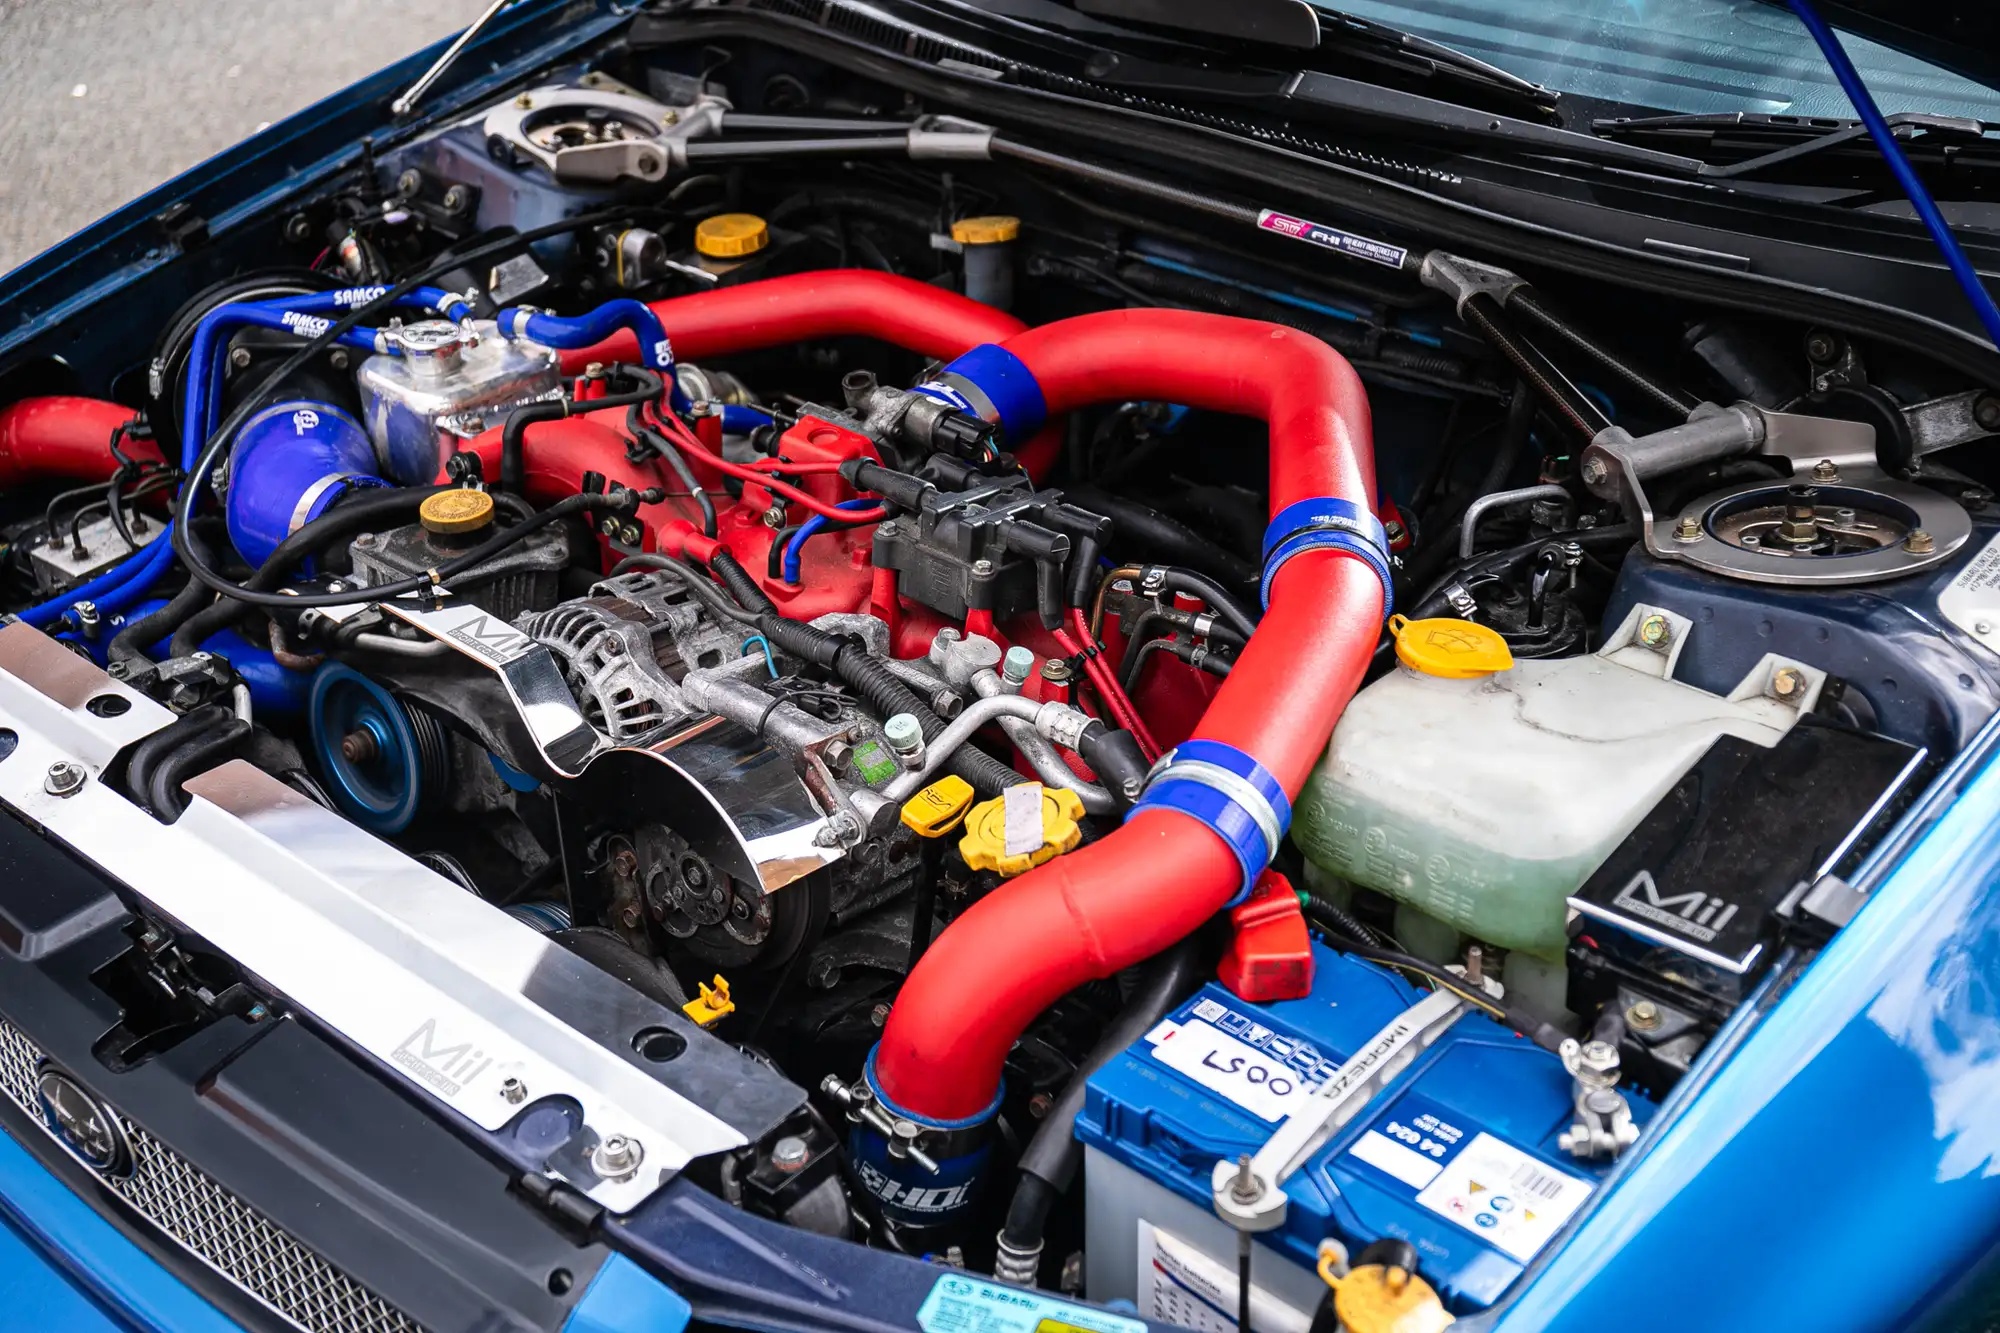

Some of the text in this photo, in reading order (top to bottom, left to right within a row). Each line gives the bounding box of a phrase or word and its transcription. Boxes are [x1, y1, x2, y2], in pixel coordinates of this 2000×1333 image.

[1311, 230, 1340, 245] FHI
[1347, 244, 1394, 263] Aerospace Division
[1366, 244, 1391, 257] INDUSTRIES
[333, 286, 386, 306] SAMCO
[281, 311, 330, 331] SAMCO
[1956, 563, 1982, 589] SUBARU
[448, 614, 530, 658] Mil
[1613, 869, 1739, 932] Mil
[395, 1018, 494, 1085] Mil
[1323, 1025, 1408, 1099] IMPREZA
